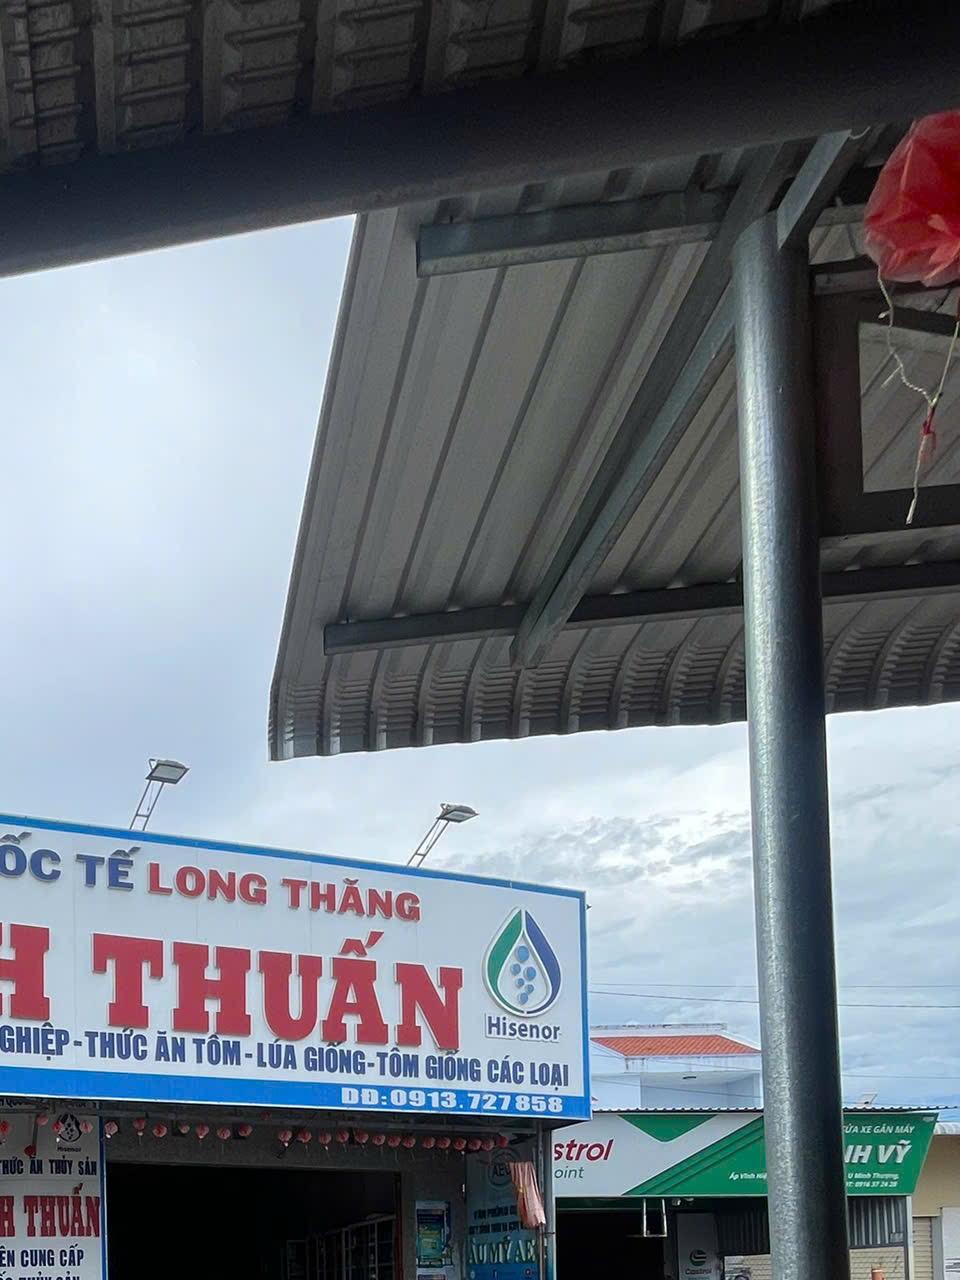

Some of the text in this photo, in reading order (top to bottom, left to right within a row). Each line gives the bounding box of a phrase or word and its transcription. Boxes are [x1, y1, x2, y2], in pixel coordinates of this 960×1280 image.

[76, 847, 141, 890] TẾ
[147, 862, 267, 906] LONG
[282, 879, 421, 922] THĂNG
[91, 931, 463, 1052] THUẤN
[486, 1014, 560, 1042] Hisenor
[155, 1030, 186, 1063] ĂN
[193, 1034, 241, 1066] TÔM
[425, 1049, 481, 1082] GIỐNG
[487, 1055, 523, 1084] CÁC
[529, 1061, 569, 1091] LOẠI
[554, 1138, 614, 1161] strol
[878, 1139, 912, 1163] VỸ
[49, 1155, 73, 1174] THỦY
[78, 1156, 97, 1175] SẢN
[554, 1166, 584, 1179] oint
[23, 1183, 101, 1237] THUẤN
[21, 1249, 54, 1267] CUNG
[60, 1244, 84, 1267] CẤP
